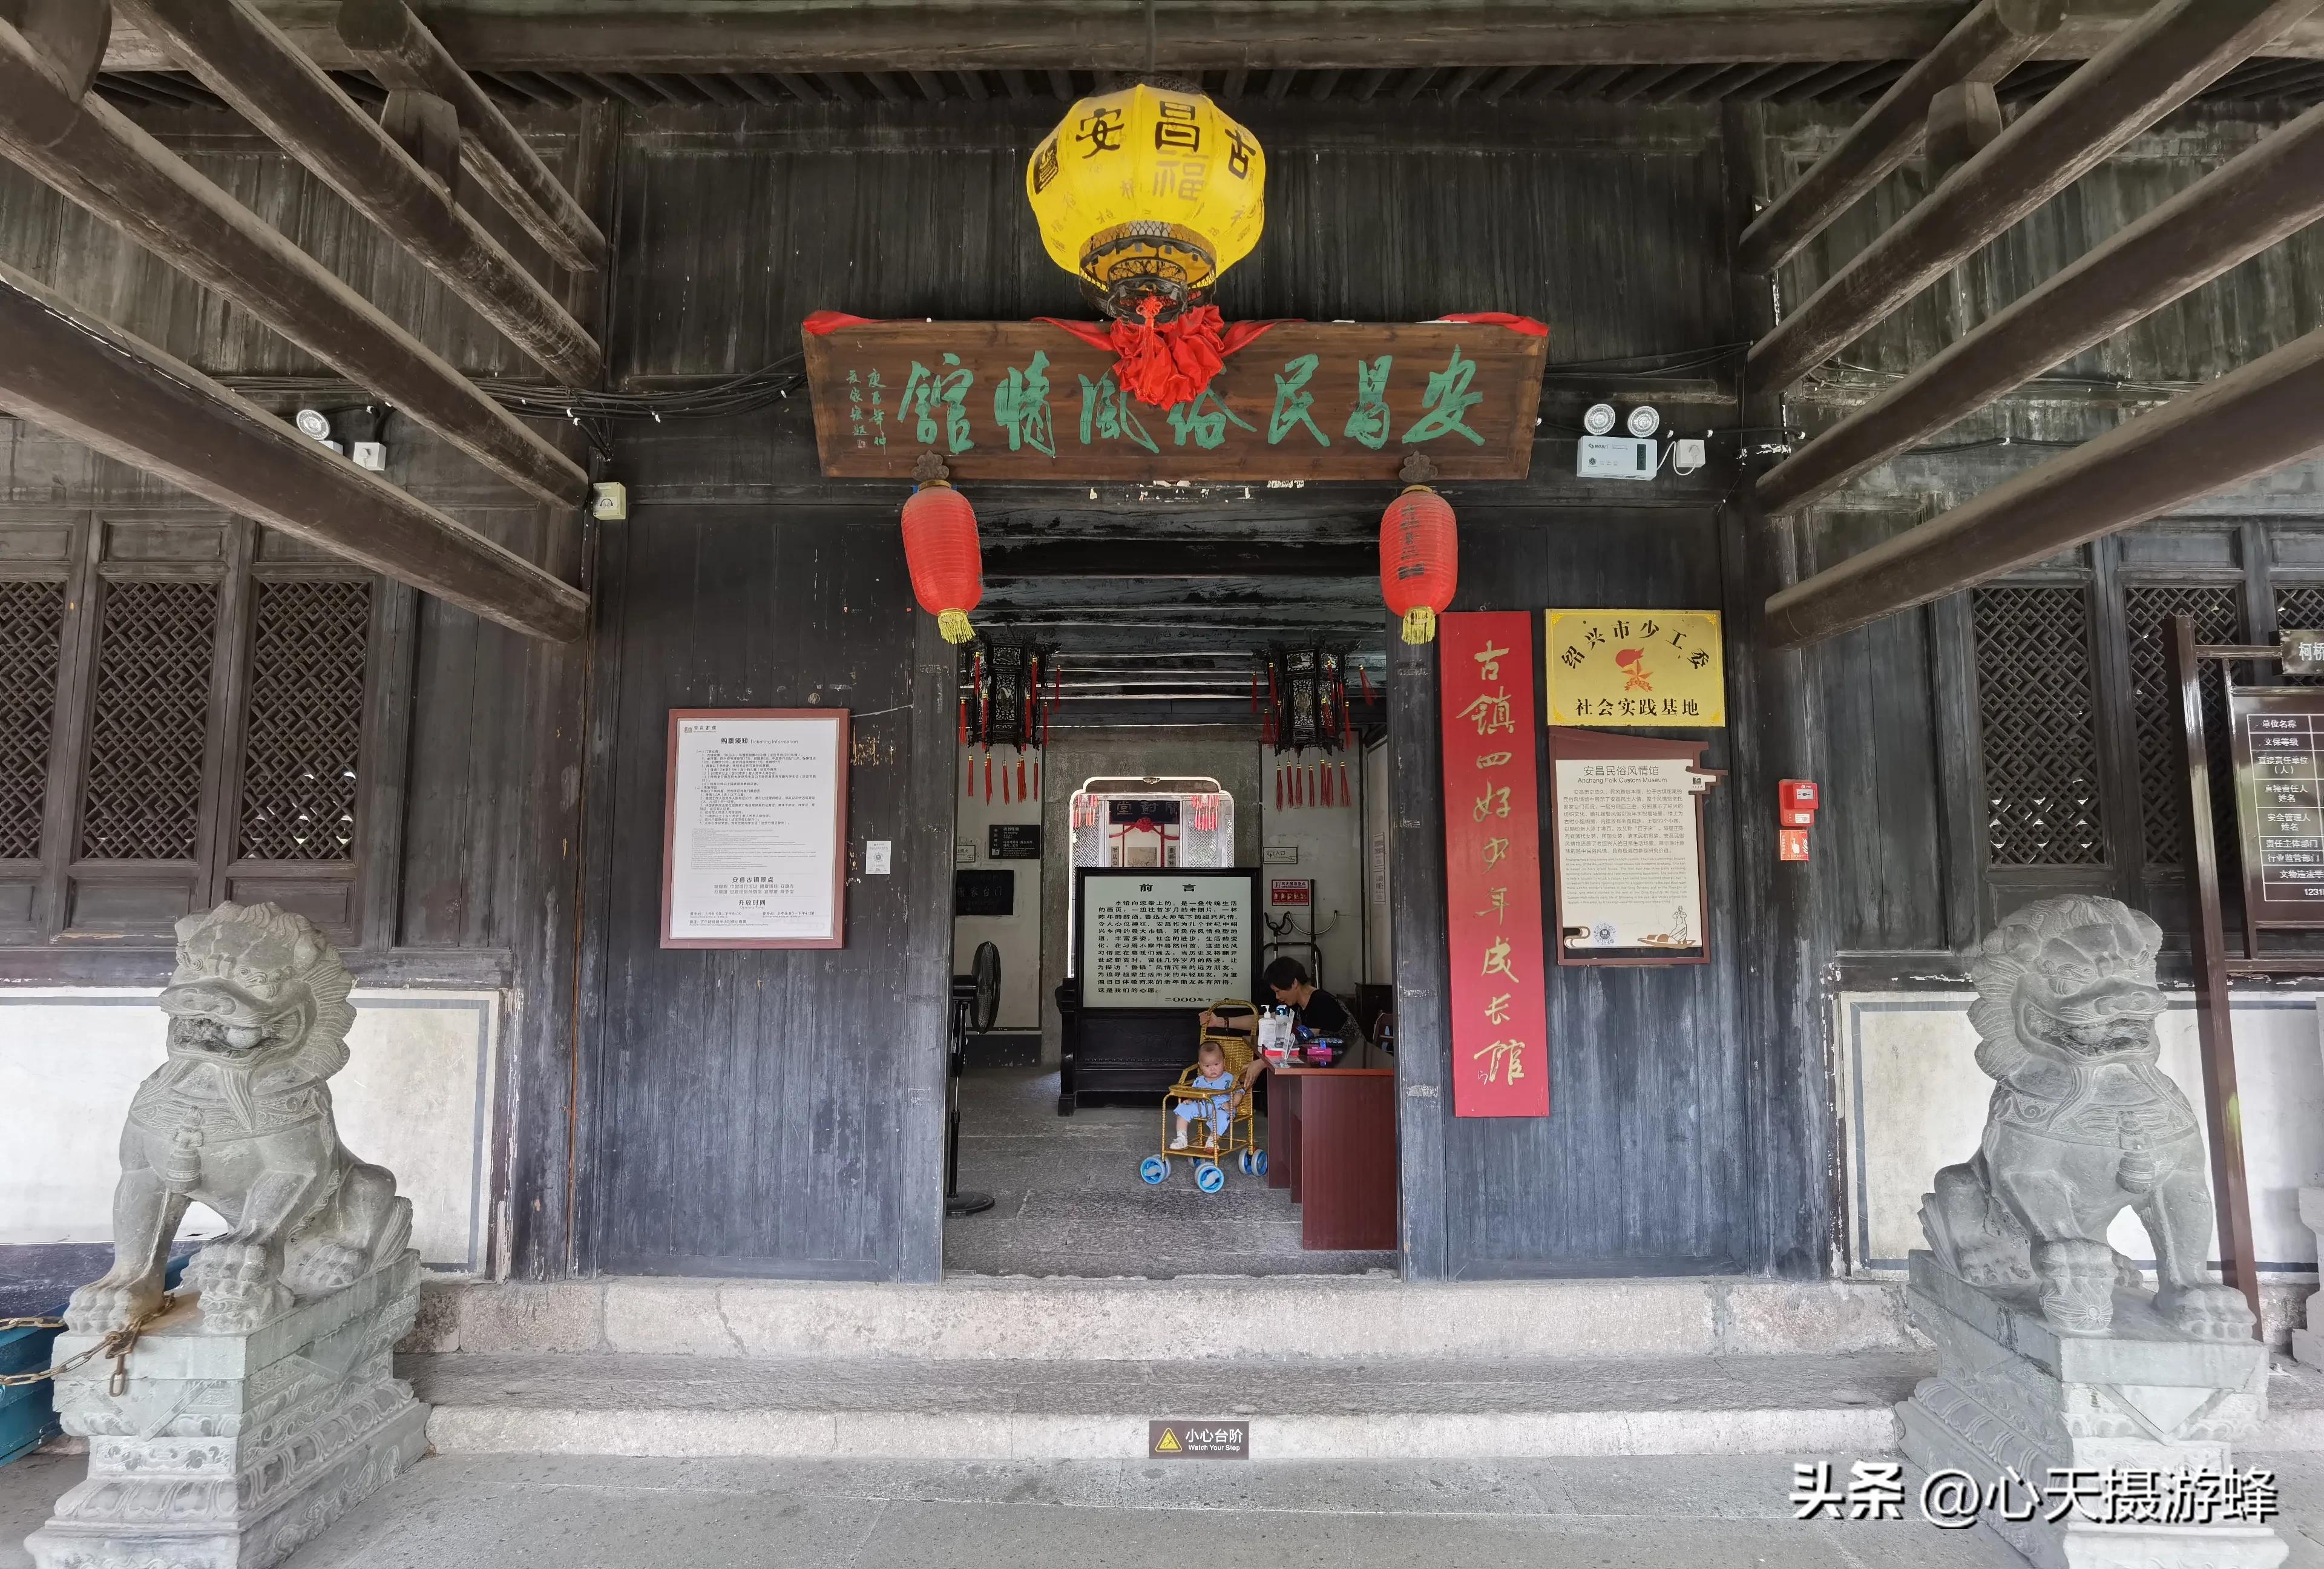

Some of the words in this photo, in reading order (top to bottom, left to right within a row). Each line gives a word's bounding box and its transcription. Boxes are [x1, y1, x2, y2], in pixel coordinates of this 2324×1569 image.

[1561, 619, 1710, 669] 绍兴市少工委
[1575, 698, 1699, 716] 社会实践基地
[2262, 720, 2297, 728] 单位名称
[1584, 766, 1659, 776] 安昌民俗风情馆
[2265, 784, 2308, 793] 直接责任人
[2267, 813, 2311, 821] 安全管理人
[2280, 823, 2299, 831] 姓名
[1139, 884, 1196, 892] 前言
[1185, 1428, 1243, 1443] 小心台阶
